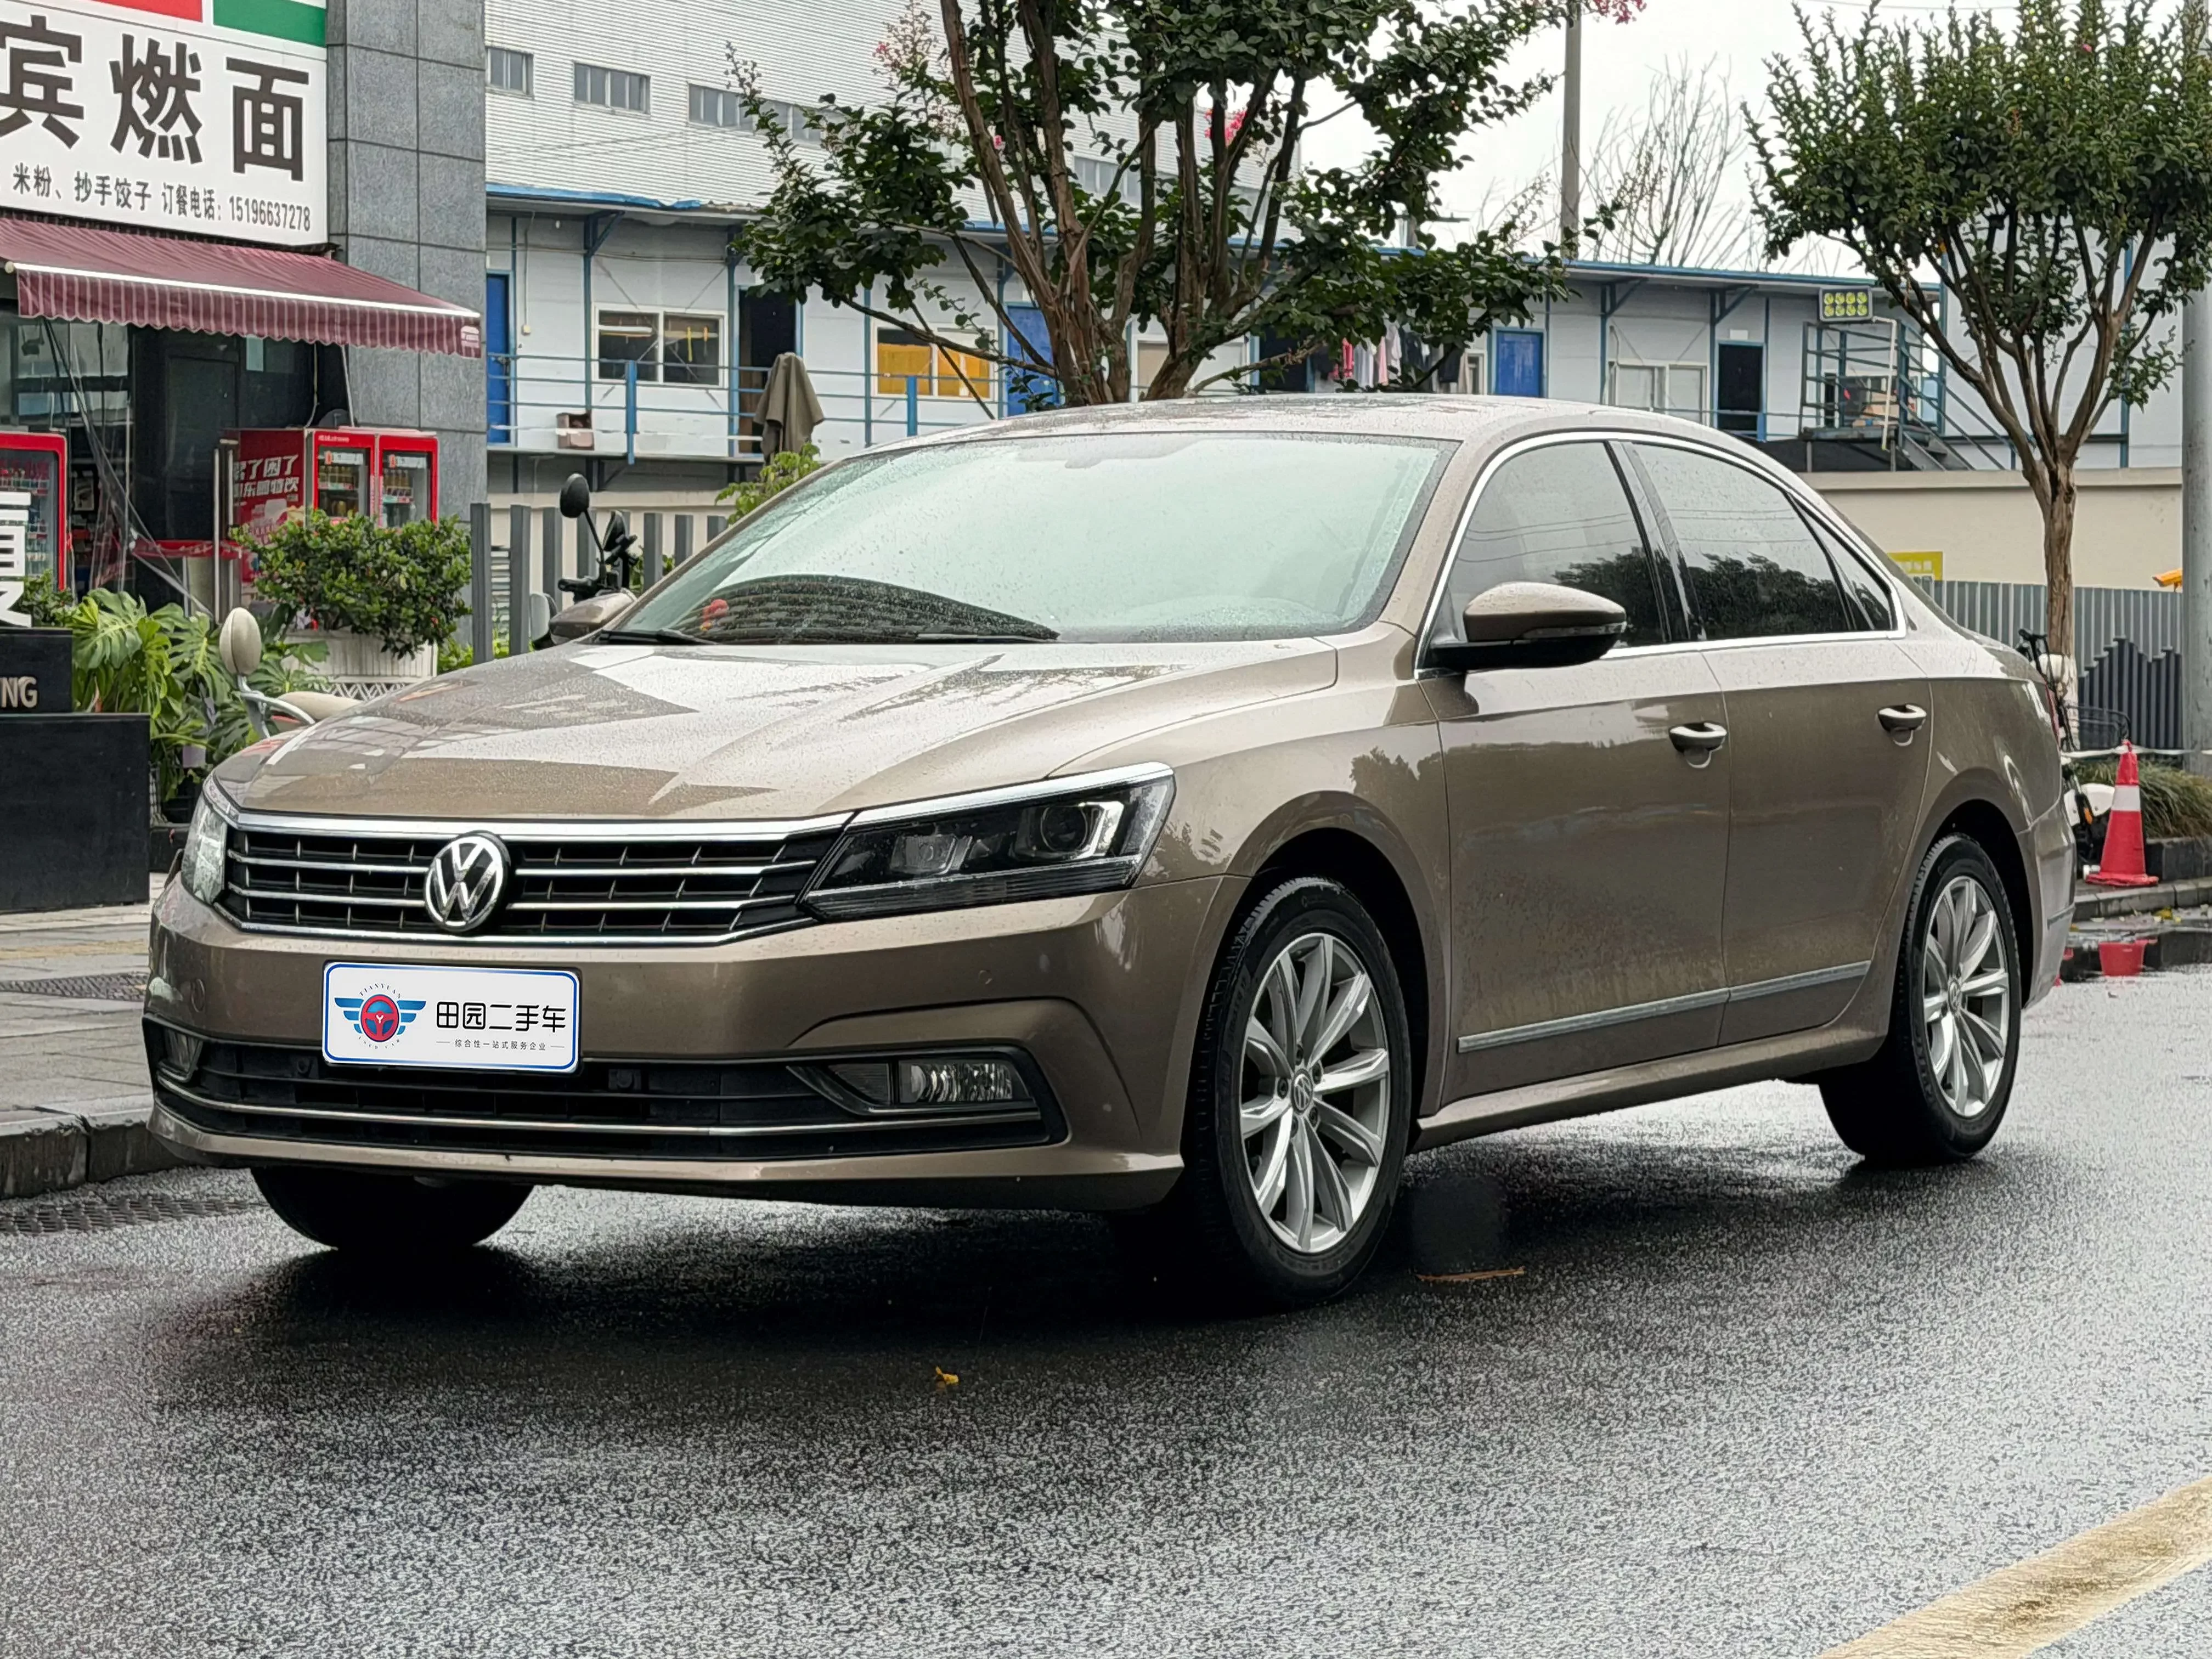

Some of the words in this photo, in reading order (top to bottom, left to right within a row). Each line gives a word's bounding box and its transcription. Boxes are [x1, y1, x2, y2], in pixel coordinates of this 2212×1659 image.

[0, 15, 310, 181] 宾燃面
[13, 162, 152, 211] 米粉、抄手饺子
[229, 195, 311, 232] 15196637278
